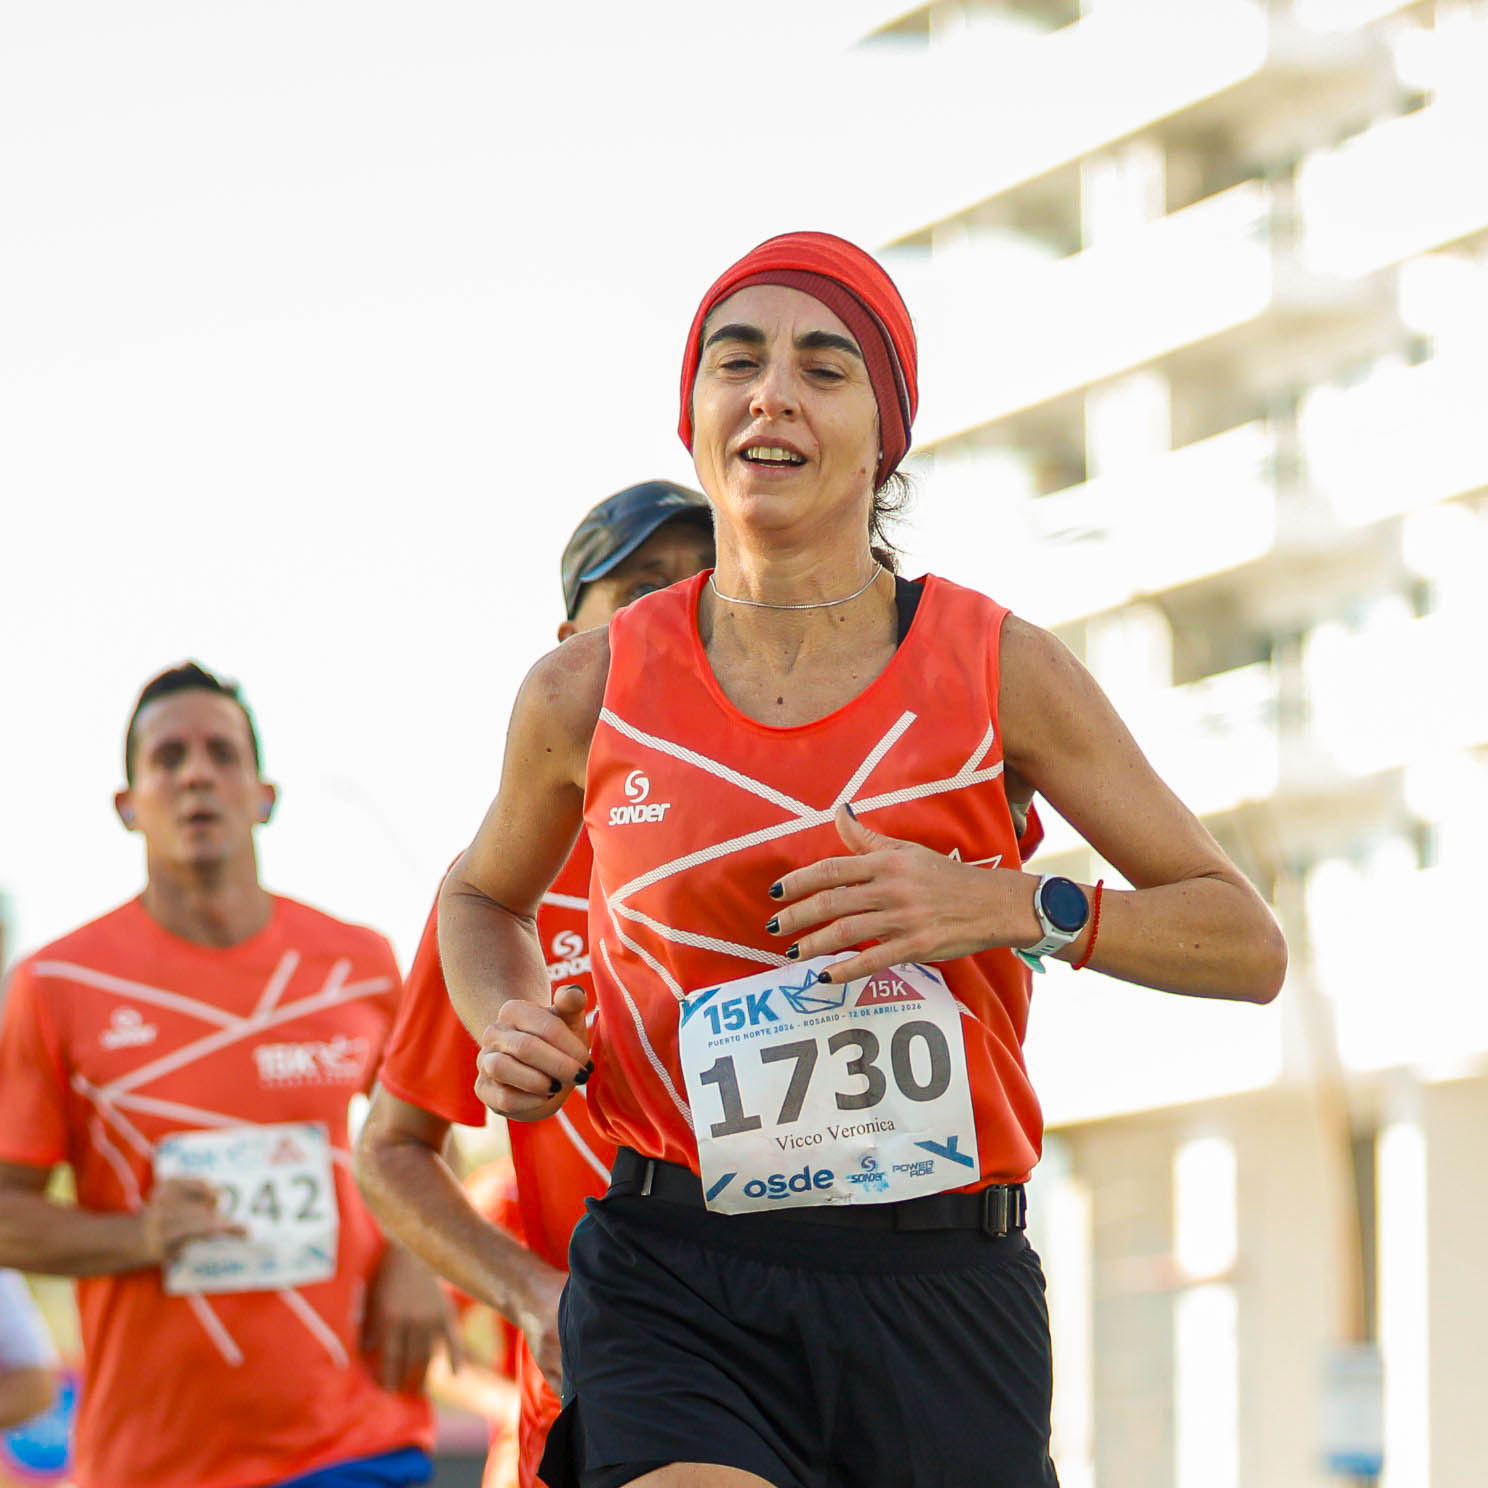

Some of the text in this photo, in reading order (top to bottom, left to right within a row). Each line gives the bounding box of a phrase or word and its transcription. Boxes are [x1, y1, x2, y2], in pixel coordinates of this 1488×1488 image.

[868, 980, 908, 999] 15K
[703, 989, 778, 1034] 15K
[708, 1035, 741, 1048] PUERTO
[743, 1028, 772, 1040] NORTE
[773, 1023, 794, 1035] 2026
[803, 1014, 840, 1027] ROSARIO
[859, 1009, 871, 1017] DE
[873, 1006, 899, 1016] ABRIL
[901, 1003, 922, 1012] 2026
[699, 1020, 952, 1139] 1730
[775, 1117, 896, 1152] Vicco Veronica
[743, 1164, 835, 1199] osde
